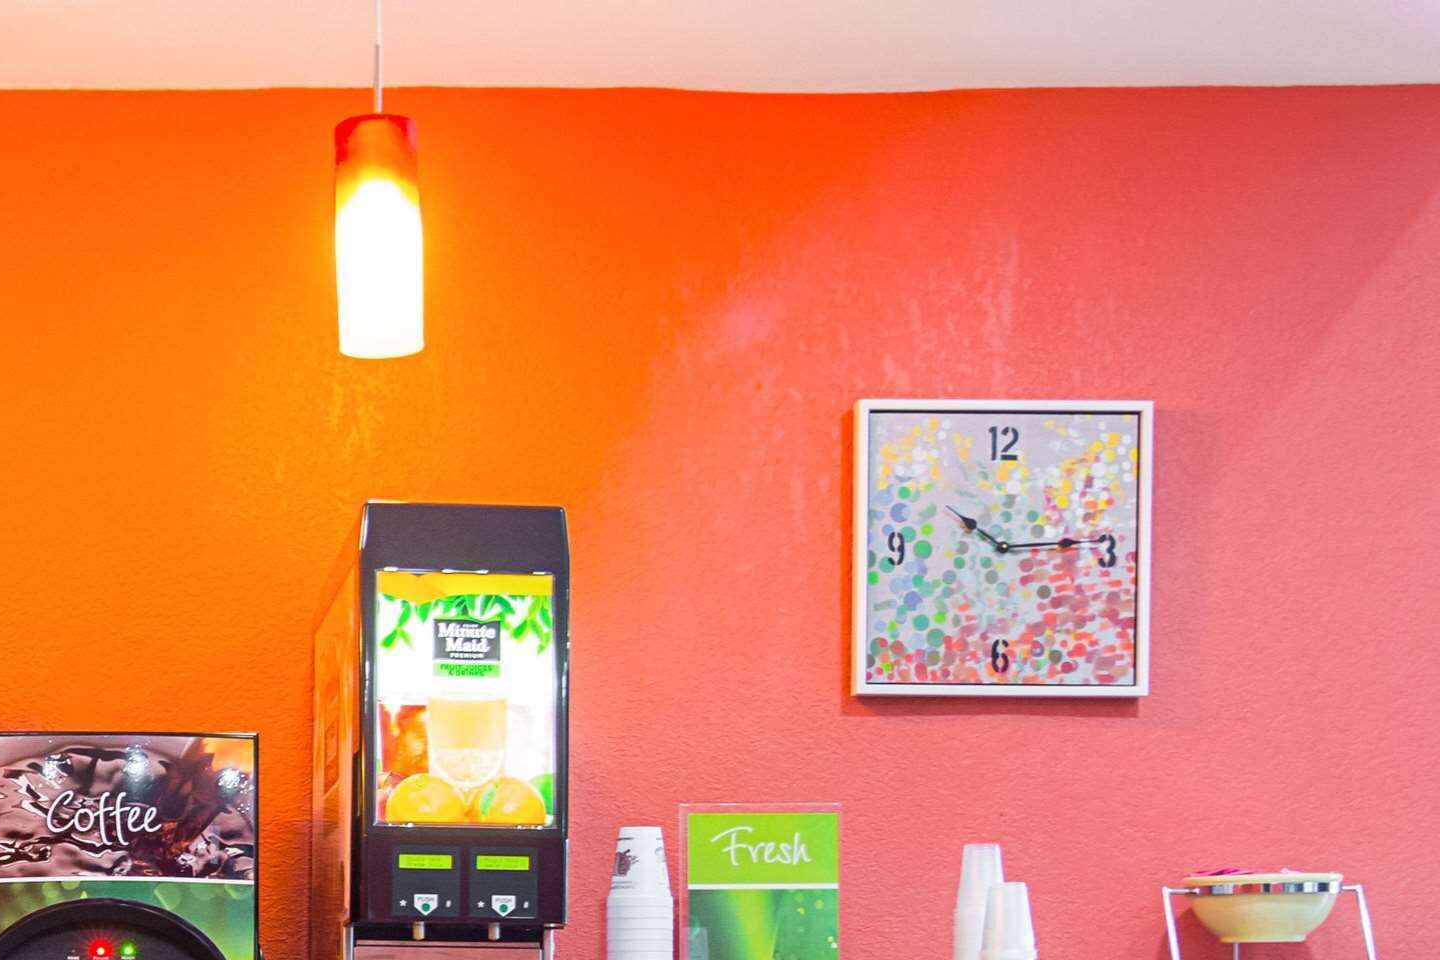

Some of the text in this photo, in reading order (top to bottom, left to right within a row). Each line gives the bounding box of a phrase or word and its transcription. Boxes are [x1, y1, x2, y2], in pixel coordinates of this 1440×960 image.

[988, 426, 1019, 461] 12
[888, 532, 905, 566] 9
[1098, 534, 1117, 568] 3
[437, 622, 497, 639] Minute
[445, 637, 489, 653] Maid
[991, 639, 1009, 673] 6
[46, 790, 162, 846] Coffee
[710, 826, 812, 866] Fresh
